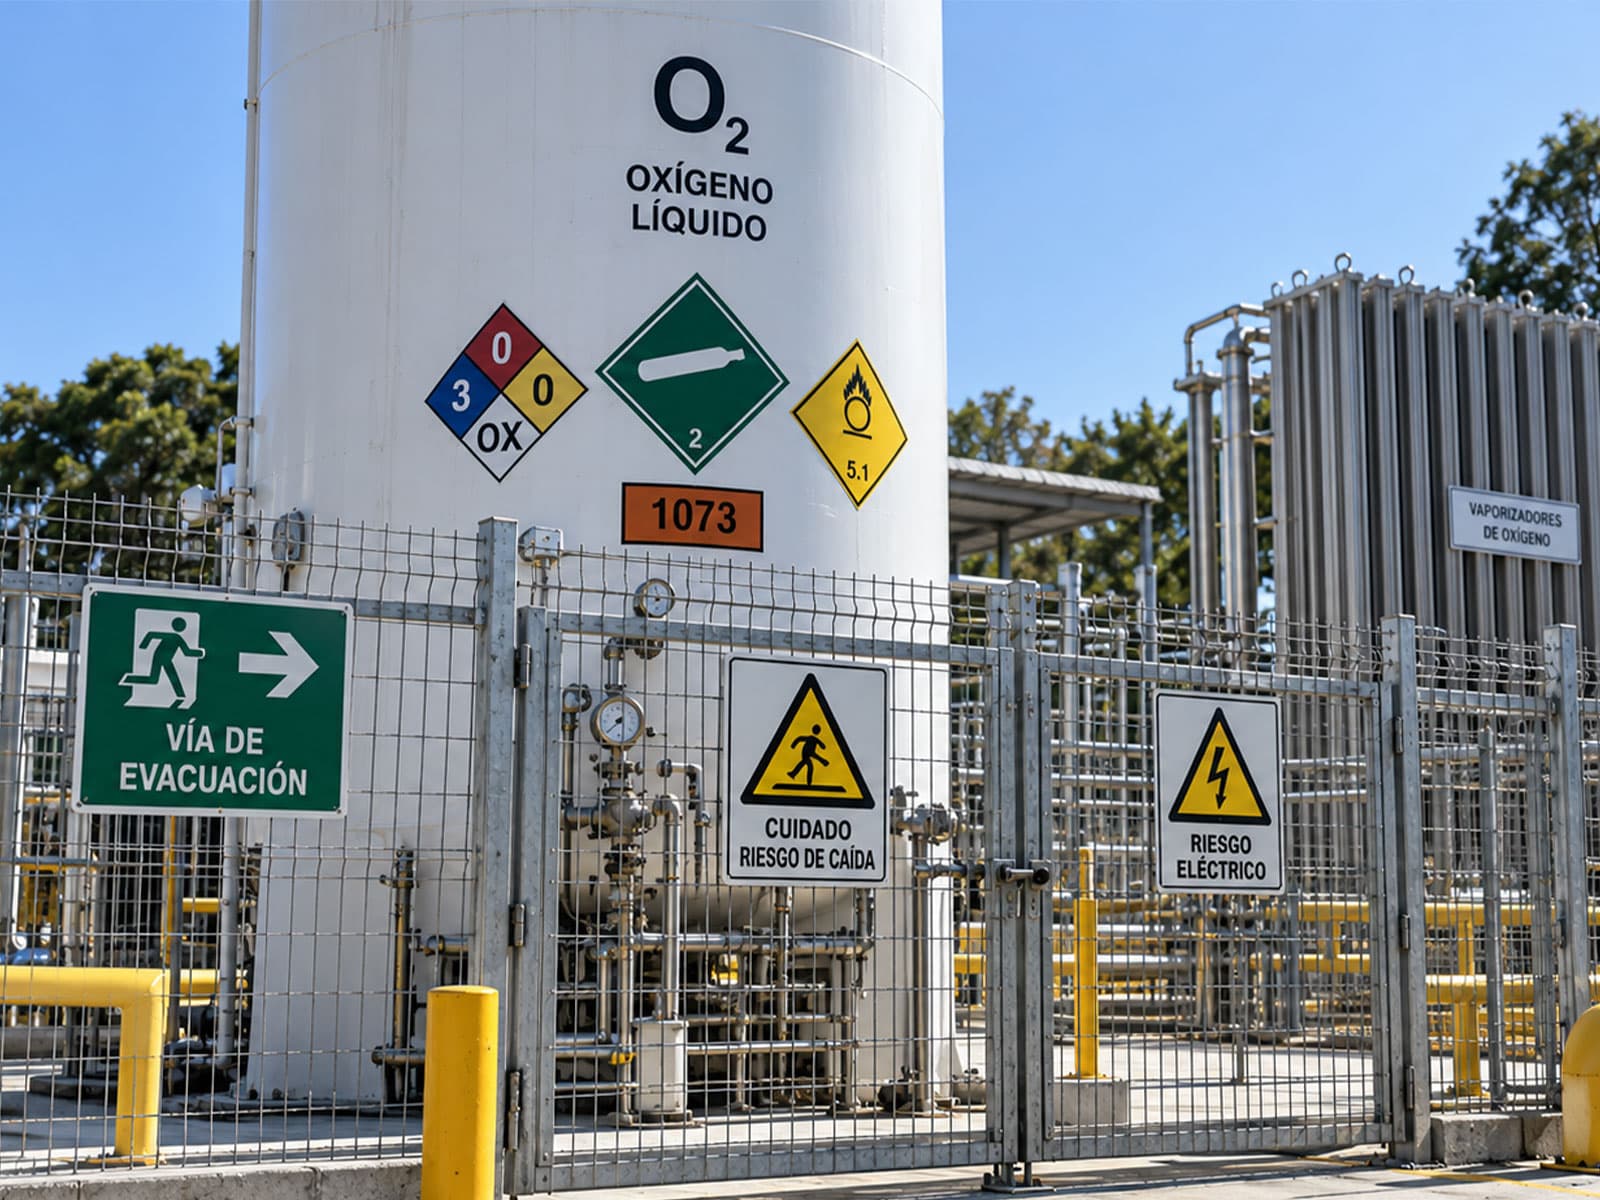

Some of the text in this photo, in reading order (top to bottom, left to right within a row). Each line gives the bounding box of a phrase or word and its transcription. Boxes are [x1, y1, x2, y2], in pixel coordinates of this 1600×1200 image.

[626, 161, 773, 204] OXÍGENO
[632, 198, 767, 241] LÍQUIDO
[492, 331, 512, 364] 0
[452, 379, 471, 412] 3
[533, 373, 554, 406] 0
[477, 421, 523, 453] OX
[689, 428, 702, 449] 2
[846, 460, 869, 481] 5.1
[652, 497, 737, 534] 1073
[1469, 502, 1562, 528] VAPORIZADORES
[1483, 525, 1551, 547] DE OXÍGENO
[166, 717, 264, 755] VÍA DE
[119, 760, 307, 796] EVACUACIÓN
[765, 817, 852, 841] CUIDADO
[1190, 834, 1252, 854] RIESGO
[740, 844, 875, 870] RIESGO DE CAÍDA
[1177, 855, 1266, 880] ELÉCTRICO
